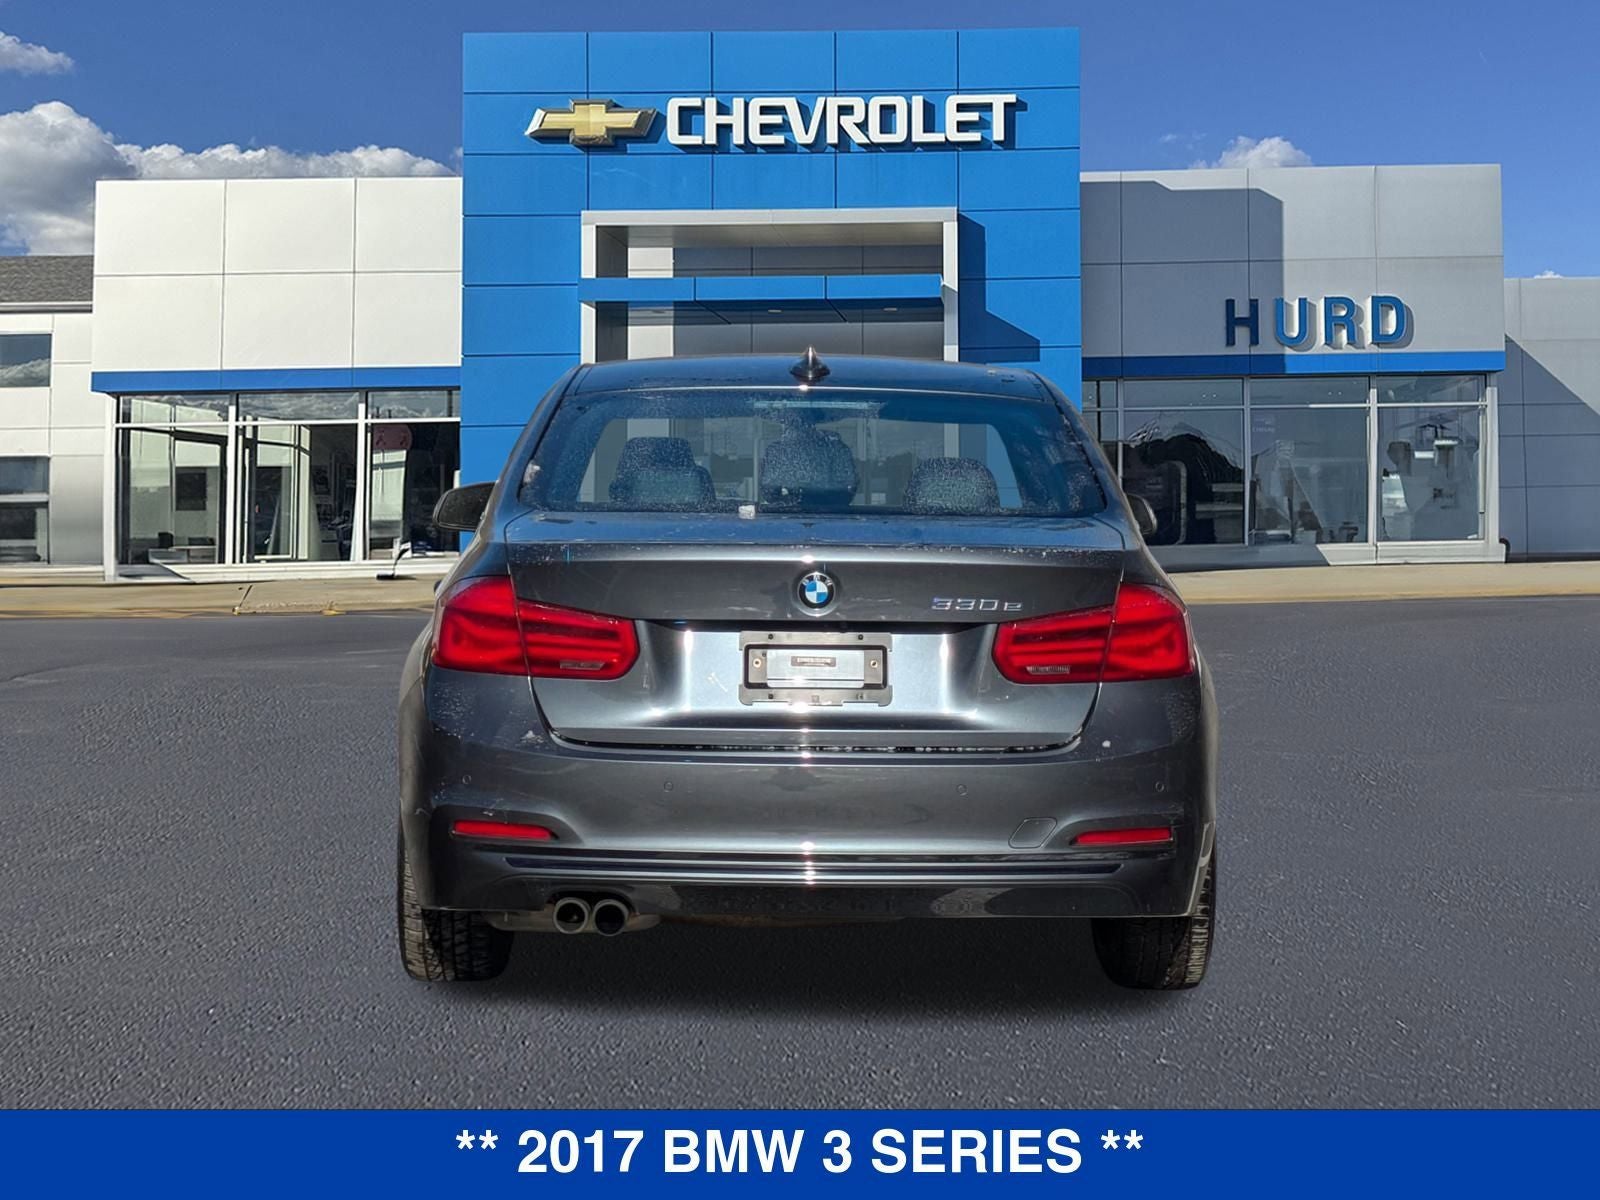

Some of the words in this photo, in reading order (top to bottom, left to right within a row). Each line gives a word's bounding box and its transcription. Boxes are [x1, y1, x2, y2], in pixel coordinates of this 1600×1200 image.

[666, 94, 1017, 146] CHEVROLET
[1225, 295, 1406, 347] HURD
[932, 598, 1022, 611] 330e
